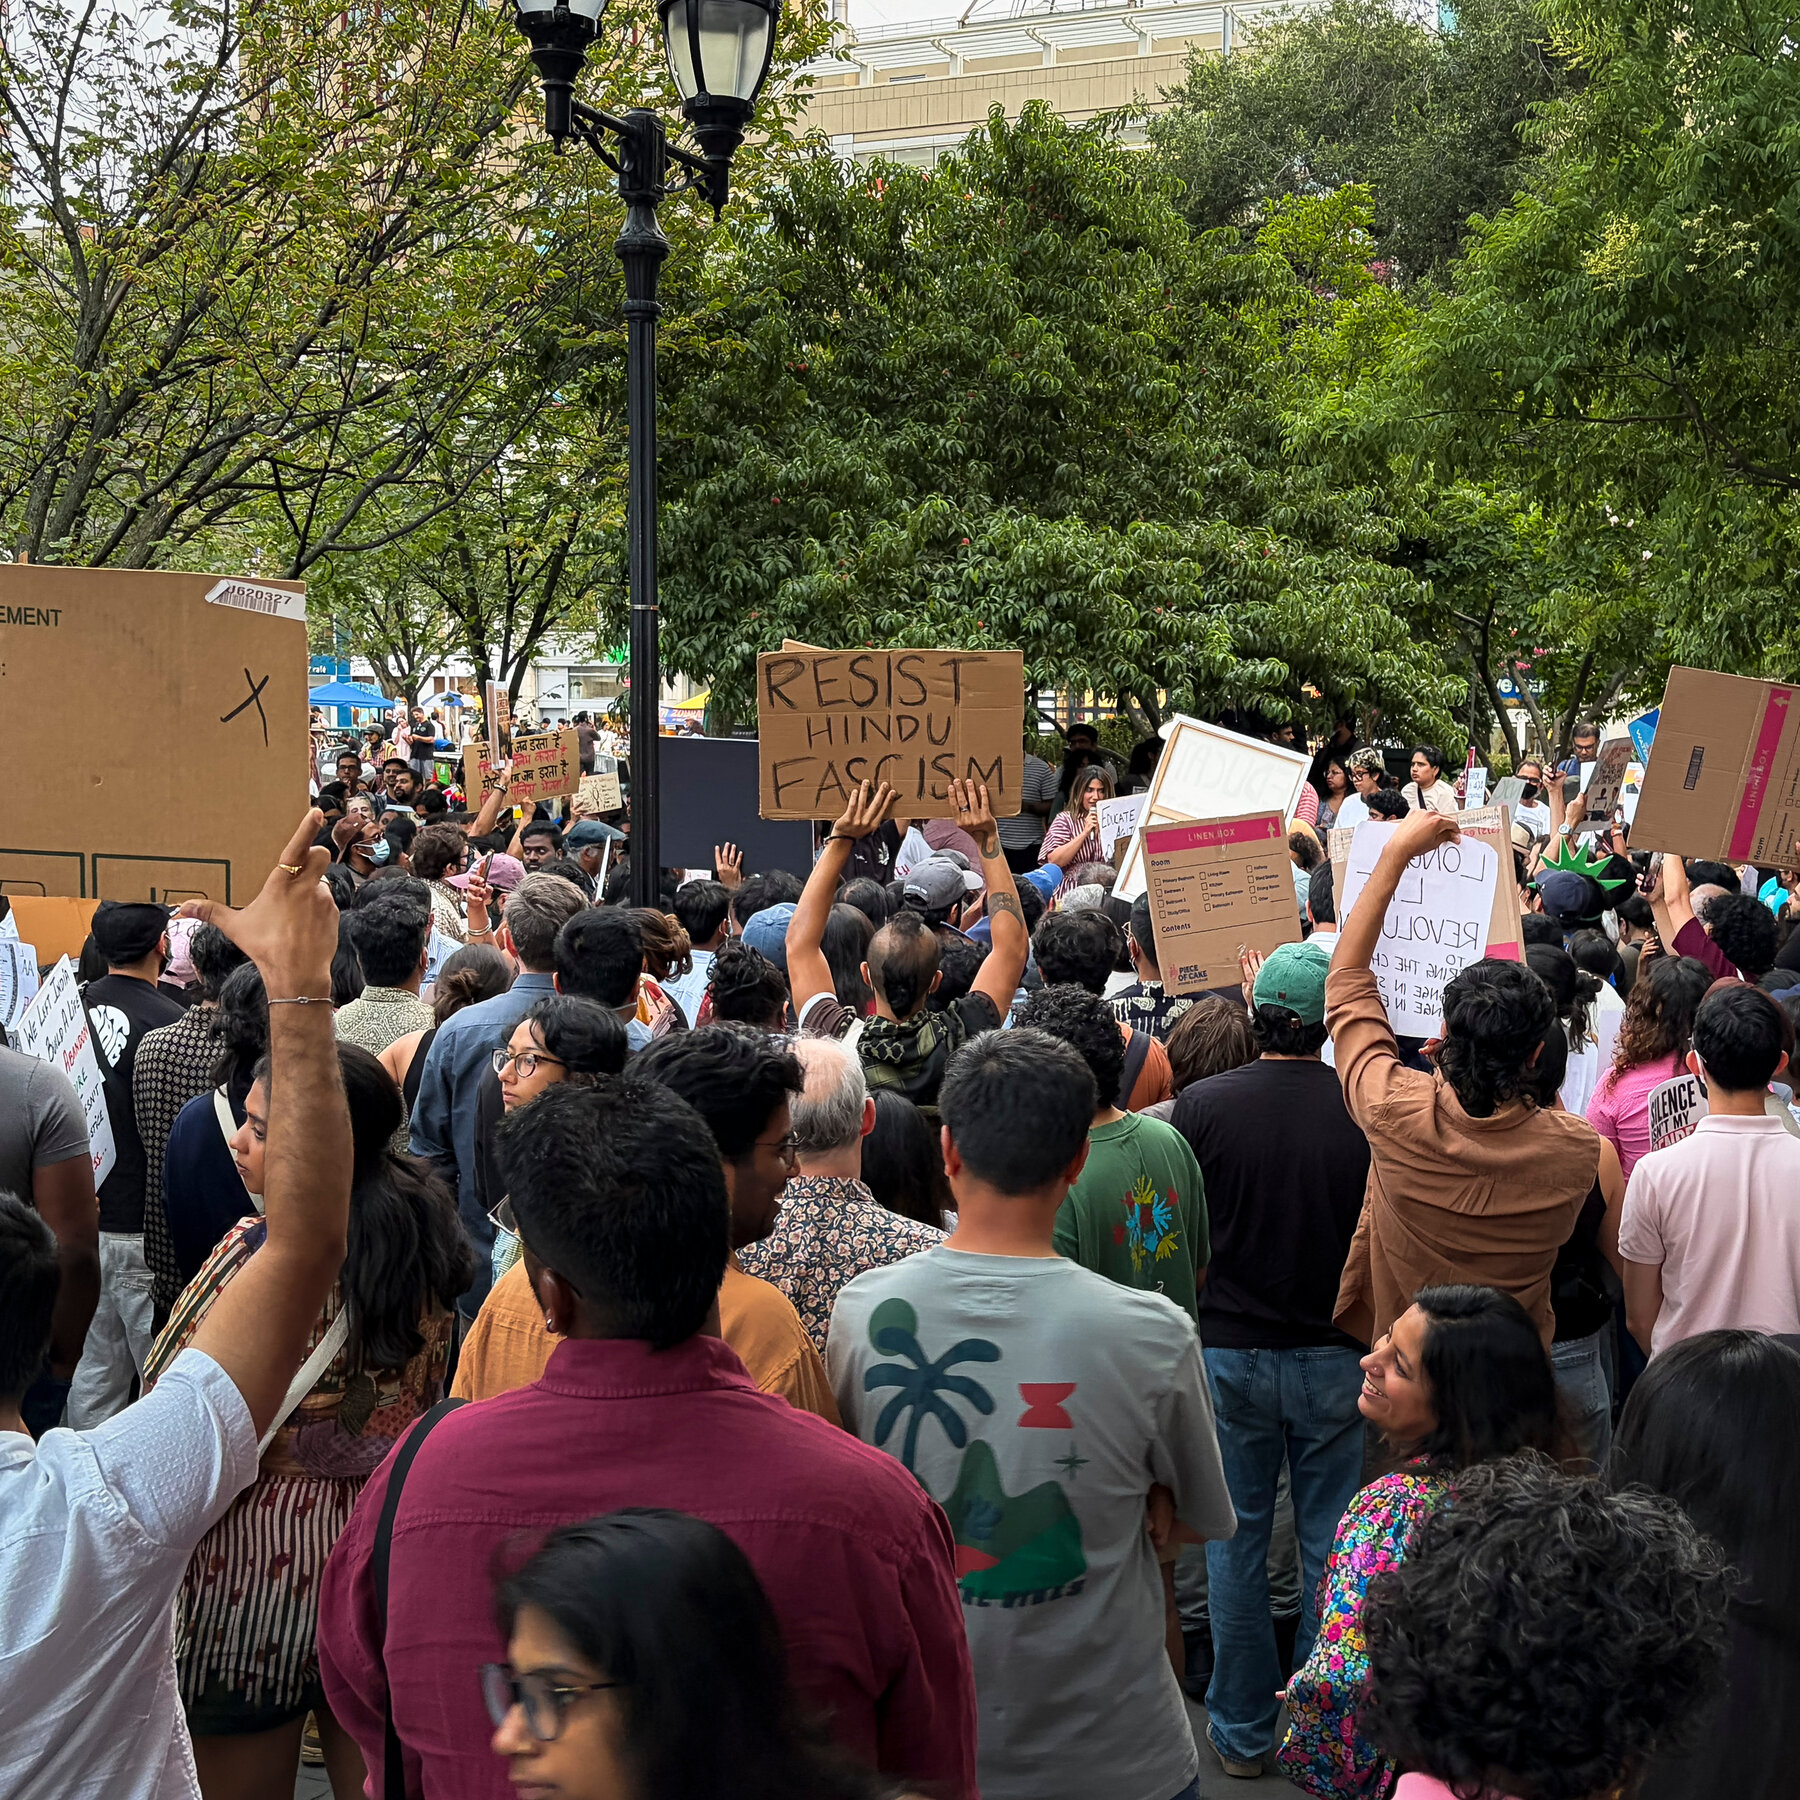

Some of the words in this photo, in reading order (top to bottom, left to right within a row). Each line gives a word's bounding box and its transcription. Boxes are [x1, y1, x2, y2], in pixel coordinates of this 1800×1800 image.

[764, 654, 989, 710] RESIST
[806, 712, 951, 749] HINDU
[771, 753, 1006, 808] FASCISM
[1102, 805, 1136, 828] EDUCATE
[1188, 832, 1214, 842] LINEN
[1217, 828, 1235, 839] BOX
[1754, 837, 1765, 861] Room
[1151, 859, 1170, 867] Room
[1161, 922, 1192, 933] Contents
[1178, 973, 1188, 982] OF
[1188, 969, 1208, 980] CAKE
[1179, 964, 1199, 974] PIECE
[1650, 1080, 1697, 1129] SILENCE
[1652, 1118, 1669, 1145] ISN'T
[1673, 1110, 1690, 1130] MY
